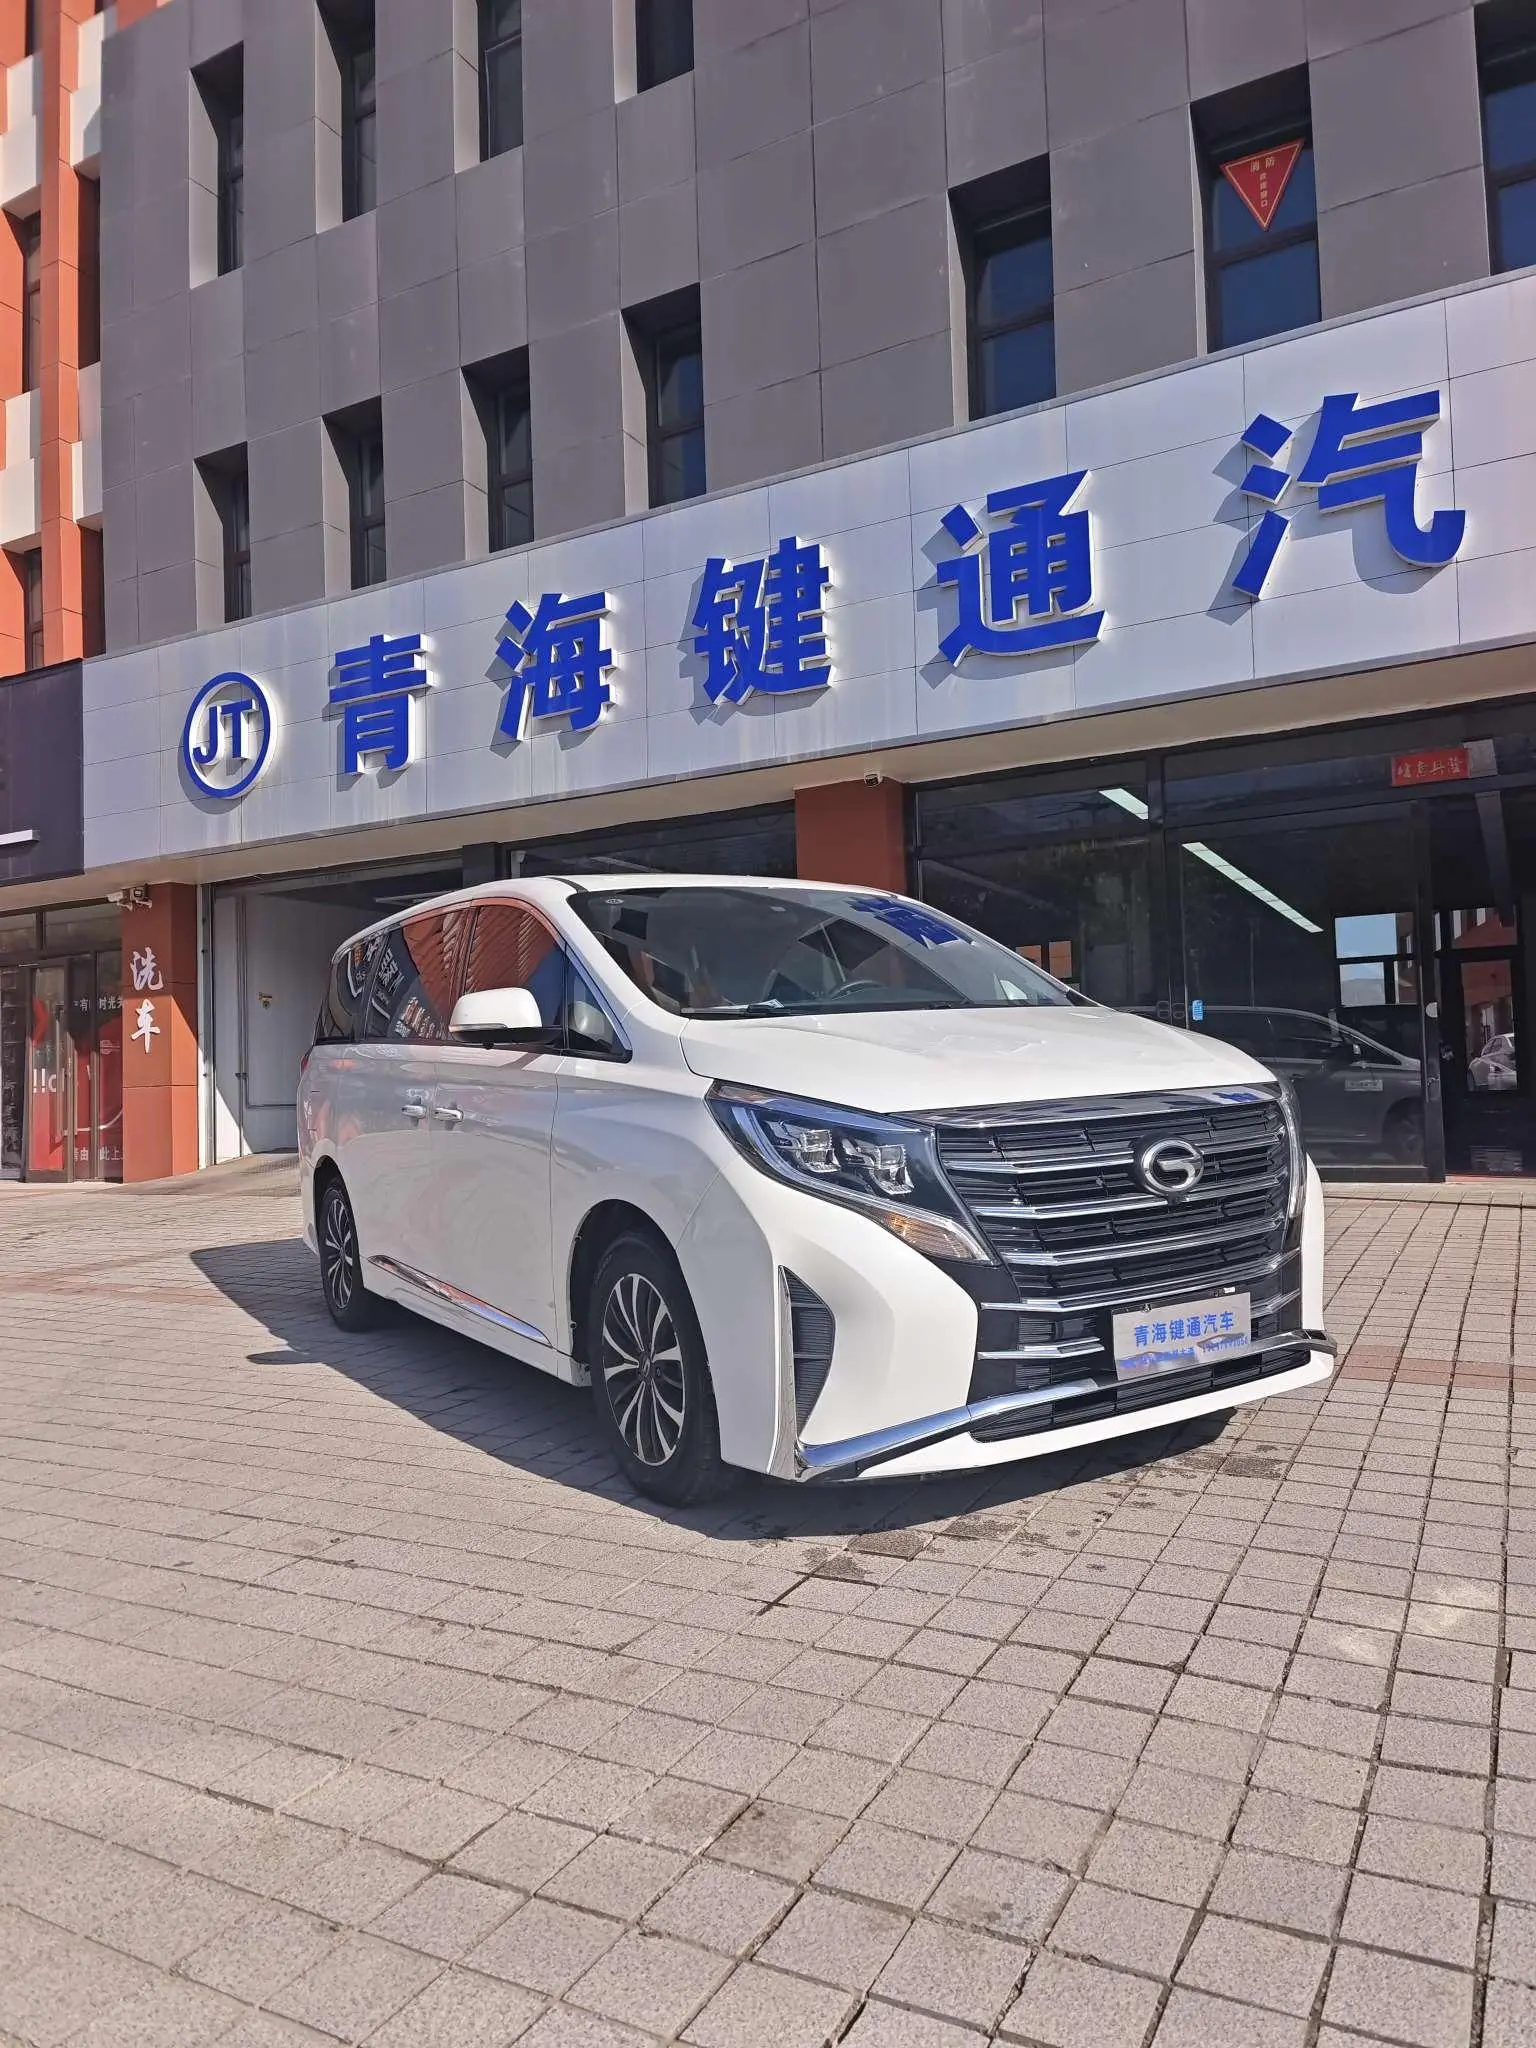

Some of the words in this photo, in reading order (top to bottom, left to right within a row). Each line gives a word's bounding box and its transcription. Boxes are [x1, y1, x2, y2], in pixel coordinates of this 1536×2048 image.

[329, 390, 1467, 775] 青海键通汽
[192, 699, 254, 765] JT
[129, 946, 163, 1054] 洗车
[1135, 1311, 1234, 1347] 青海键通汽车
